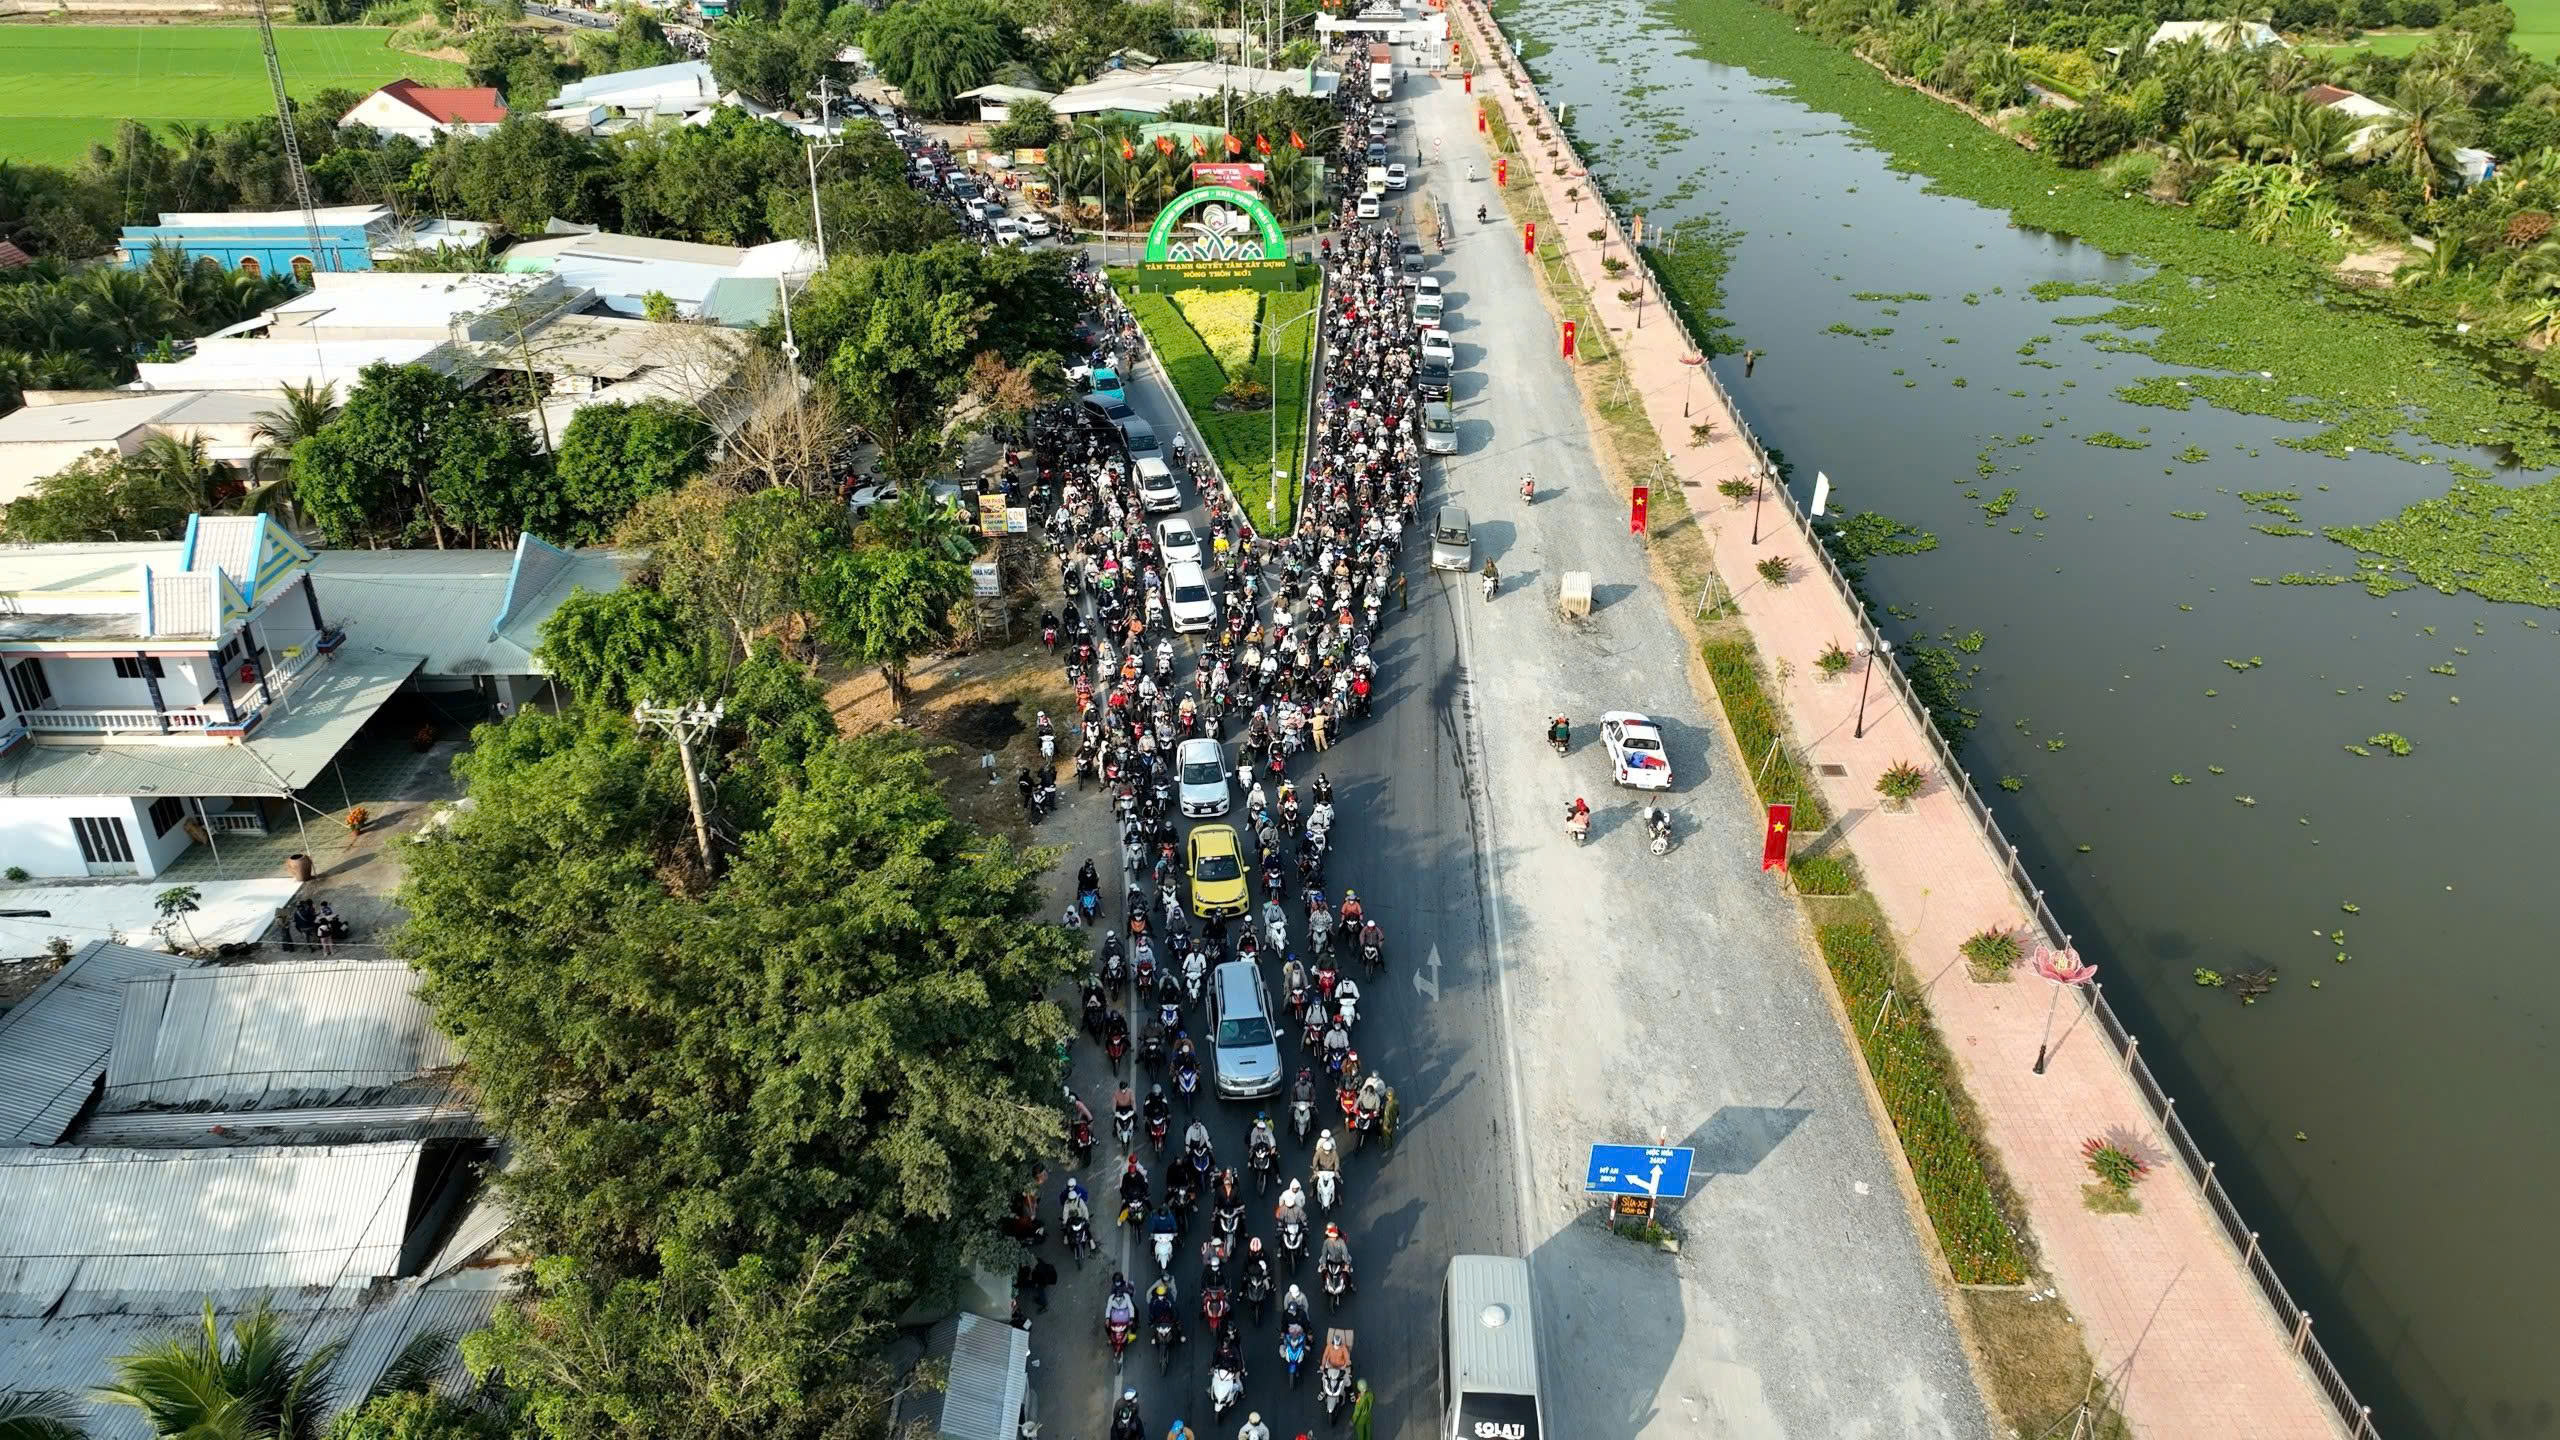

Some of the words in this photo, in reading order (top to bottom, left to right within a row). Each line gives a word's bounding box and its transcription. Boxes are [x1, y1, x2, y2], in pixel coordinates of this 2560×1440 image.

[1145, 262, 1162, 270] TÂN
[1165, 262, 1193, 271] THẠNH
[1196, 260, 1223, 270] QUYẾT
[1225, 260, 1243, 269] TÂM
[1244, 259, 1260, 268] XÂY
[1263, 261, 1286, 269] DỰNG
[1183, 270, 1206, 278] NÔNG
[1209, 270, 1231, 278] THÔN
[1233, 268, 1251, 277] MỚI
[1474, 1421, 1525, 1439] SOLATI
